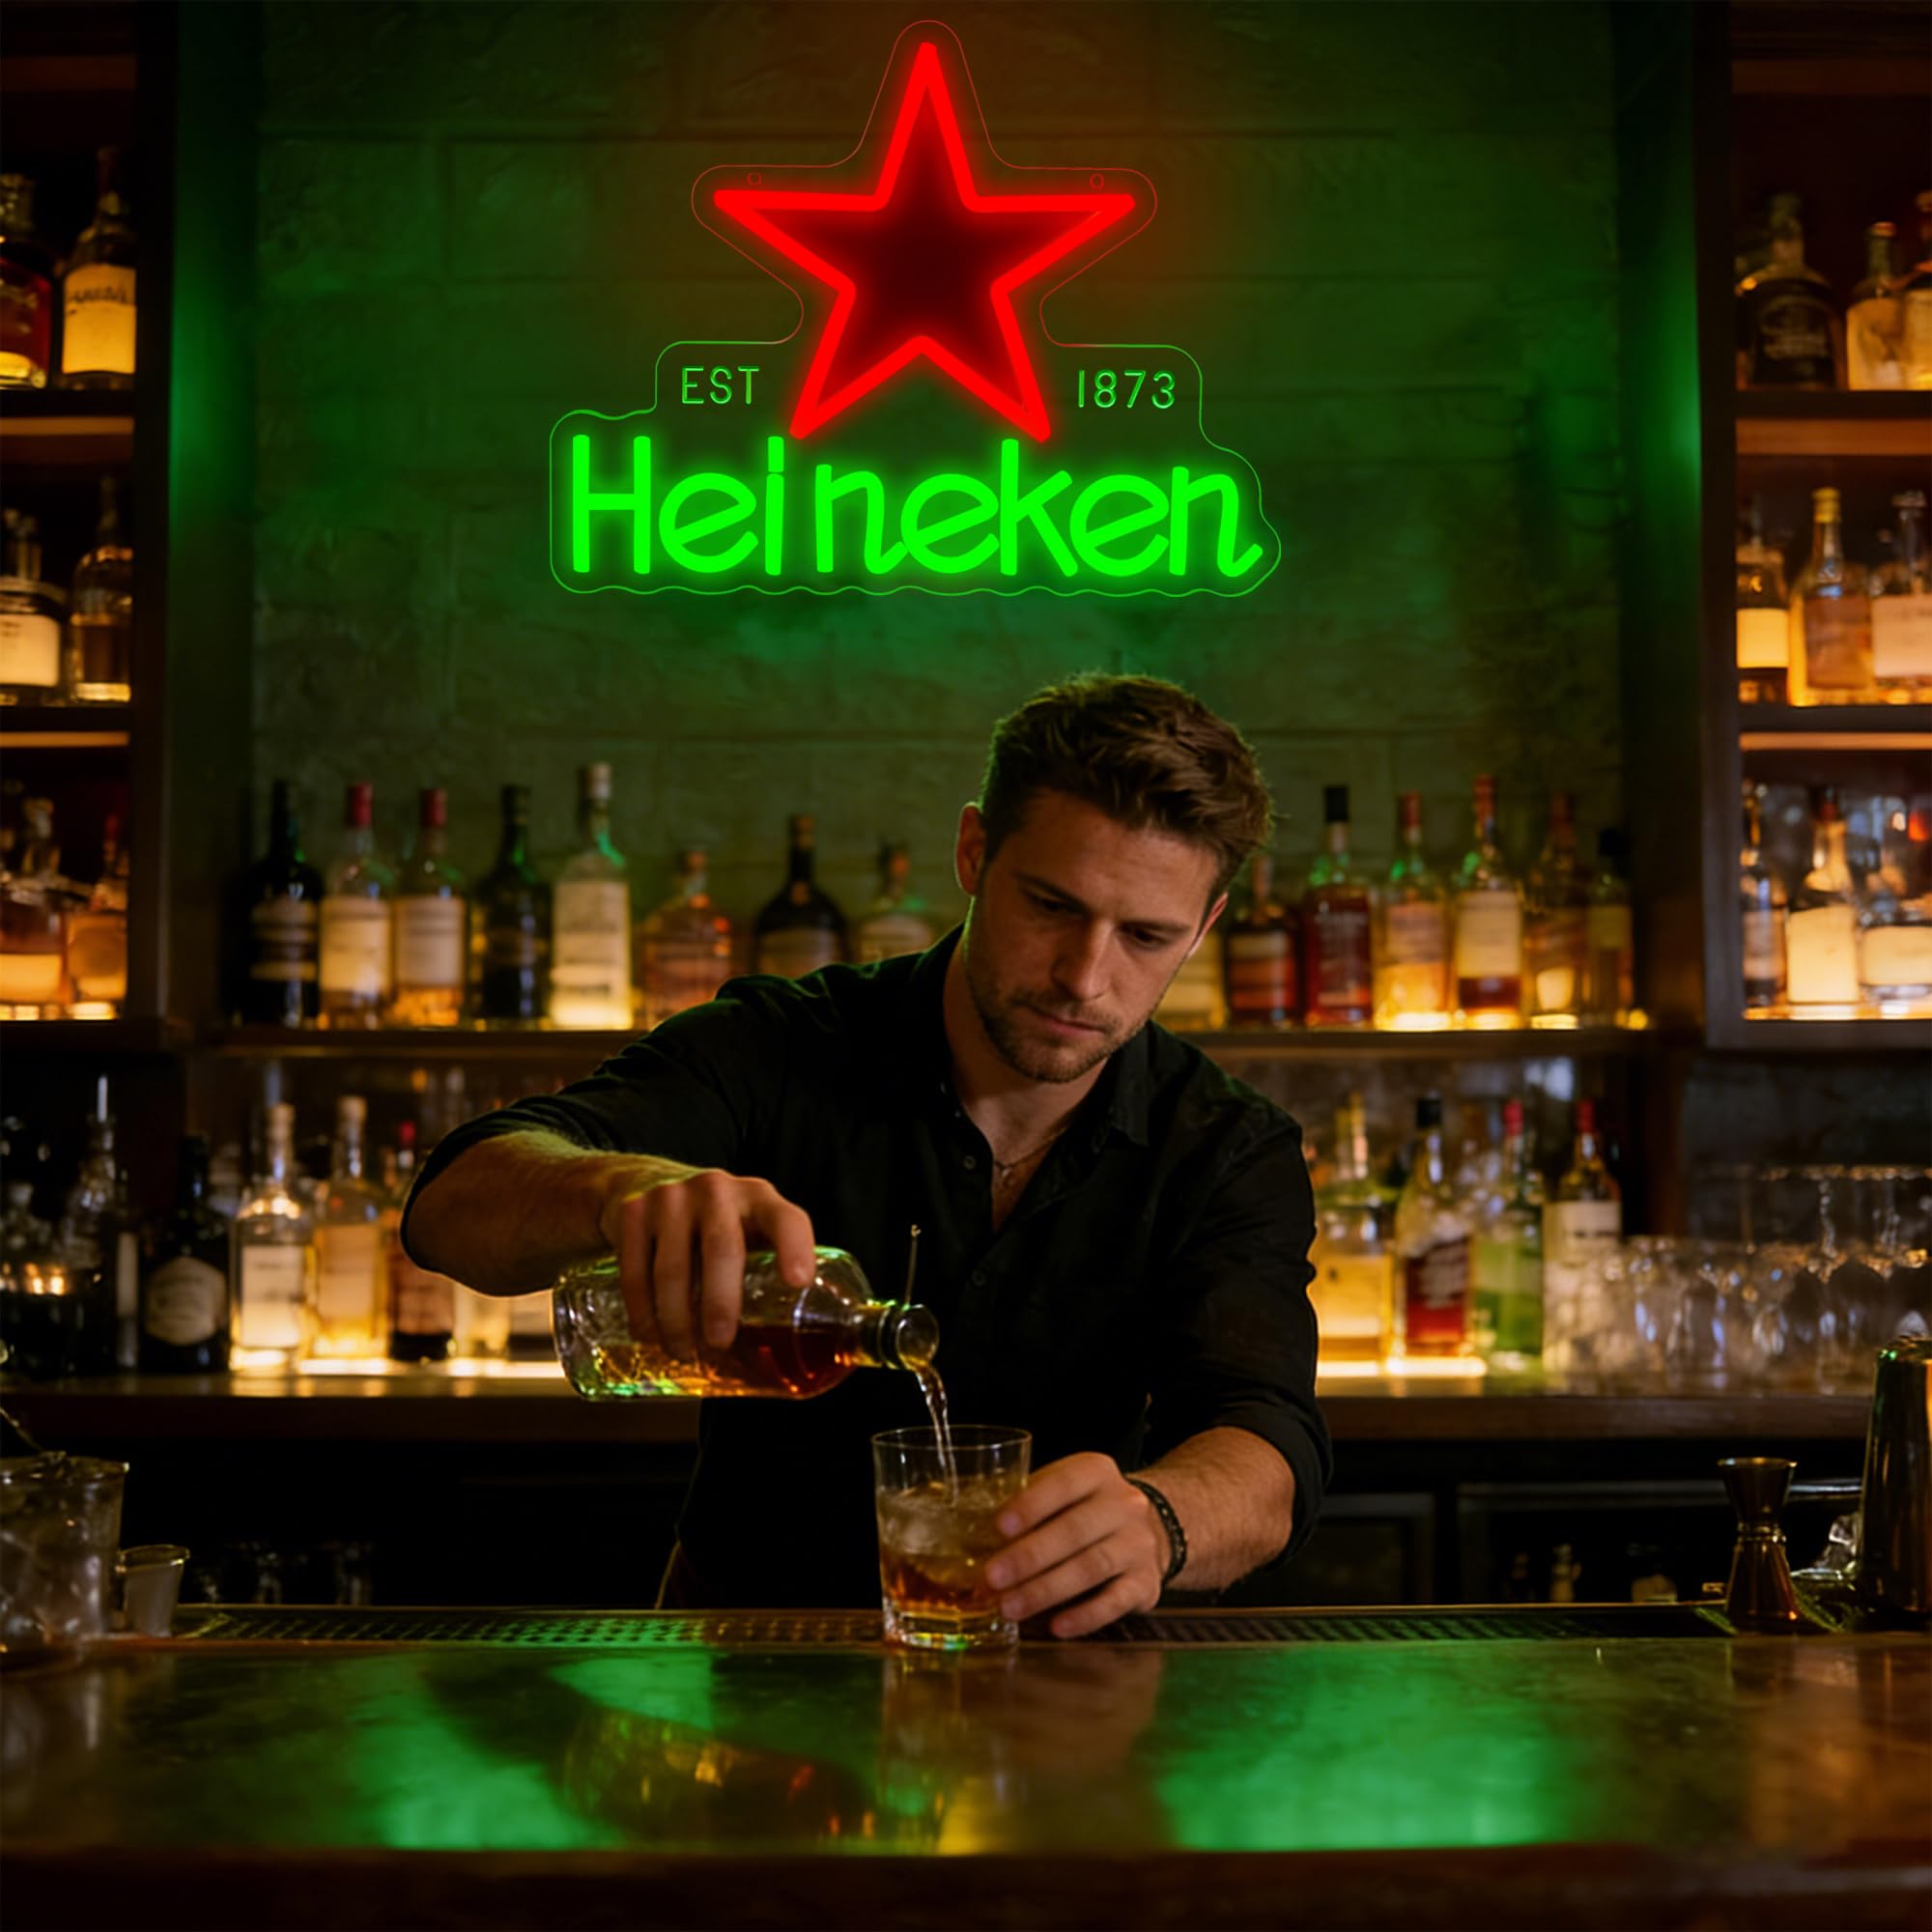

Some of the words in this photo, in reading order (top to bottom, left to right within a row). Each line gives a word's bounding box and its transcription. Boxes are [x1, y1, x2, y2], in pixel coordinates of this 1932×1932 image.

[681, 365, 760, 405] EST
[1077, 369, 1176, 410] 1873
[572, 434, 1264, 578] Heineken
